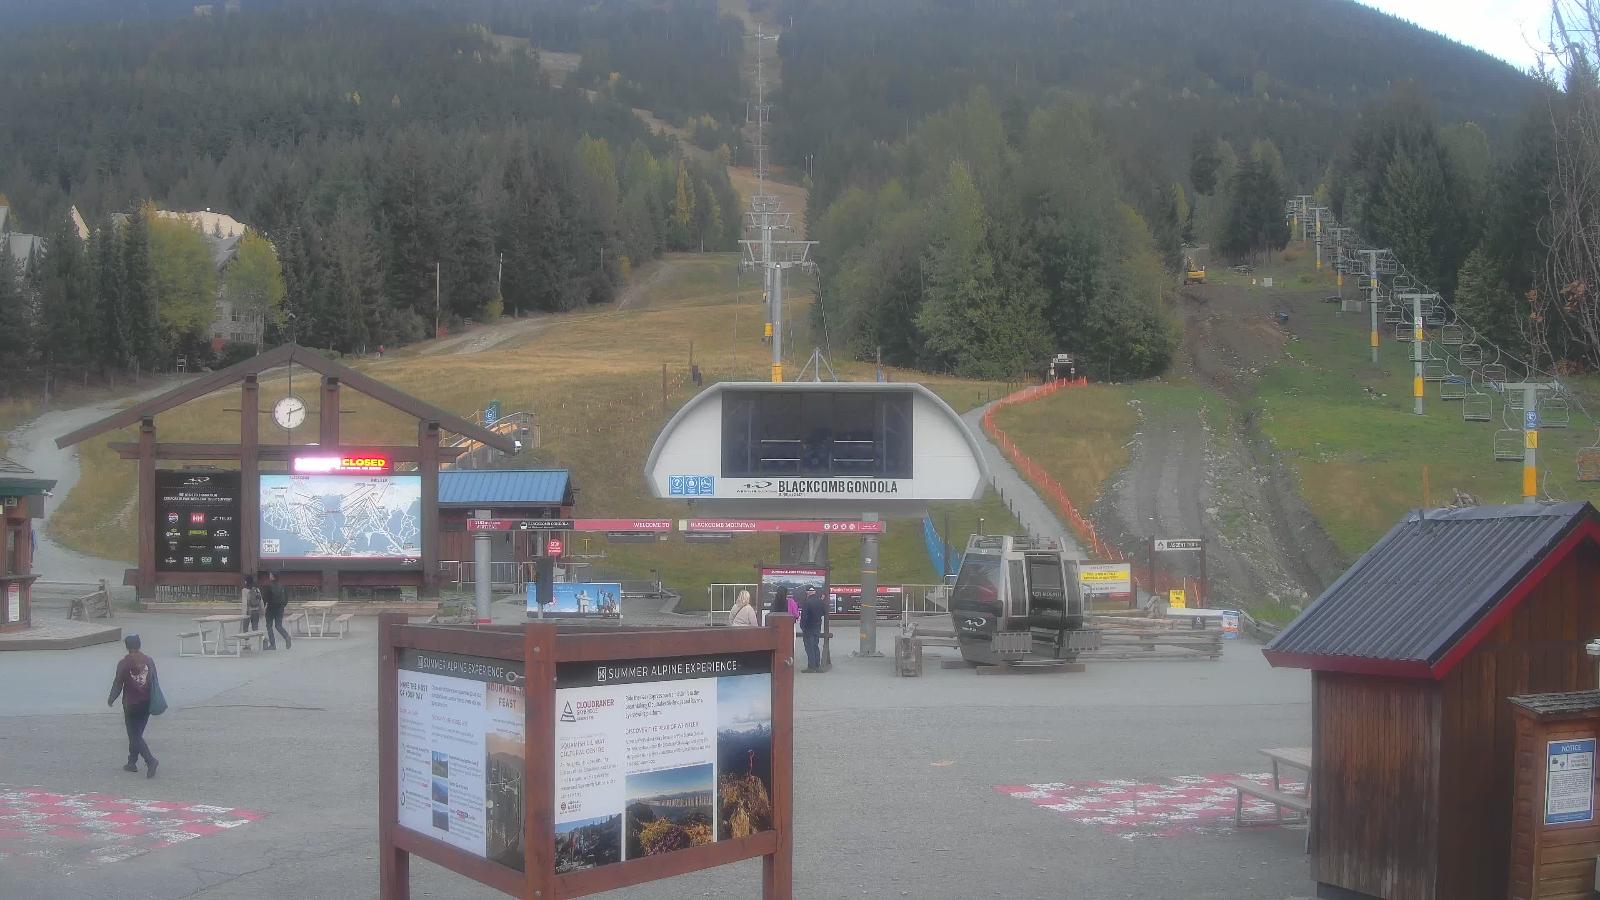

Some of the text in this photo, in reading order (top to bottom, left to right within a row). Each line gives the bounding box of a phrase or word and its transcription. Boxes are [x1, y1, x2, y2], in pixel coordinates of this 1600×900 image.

[342, 458, 386, 467] CLOSED
[778, 480, 898, 493] BLACKCOMB GONDOLA
[633, 521, 660, 529] WELCOME
[422, 656, 504, 678] SUMMER ALPINE EXPERIENCE
[608, 660, 738, 679] SUMMER ALPINE EXPERIENCE
[498, 697, 517, 710] FEAST
[1561, 744, 1582, 753] NOTICE
